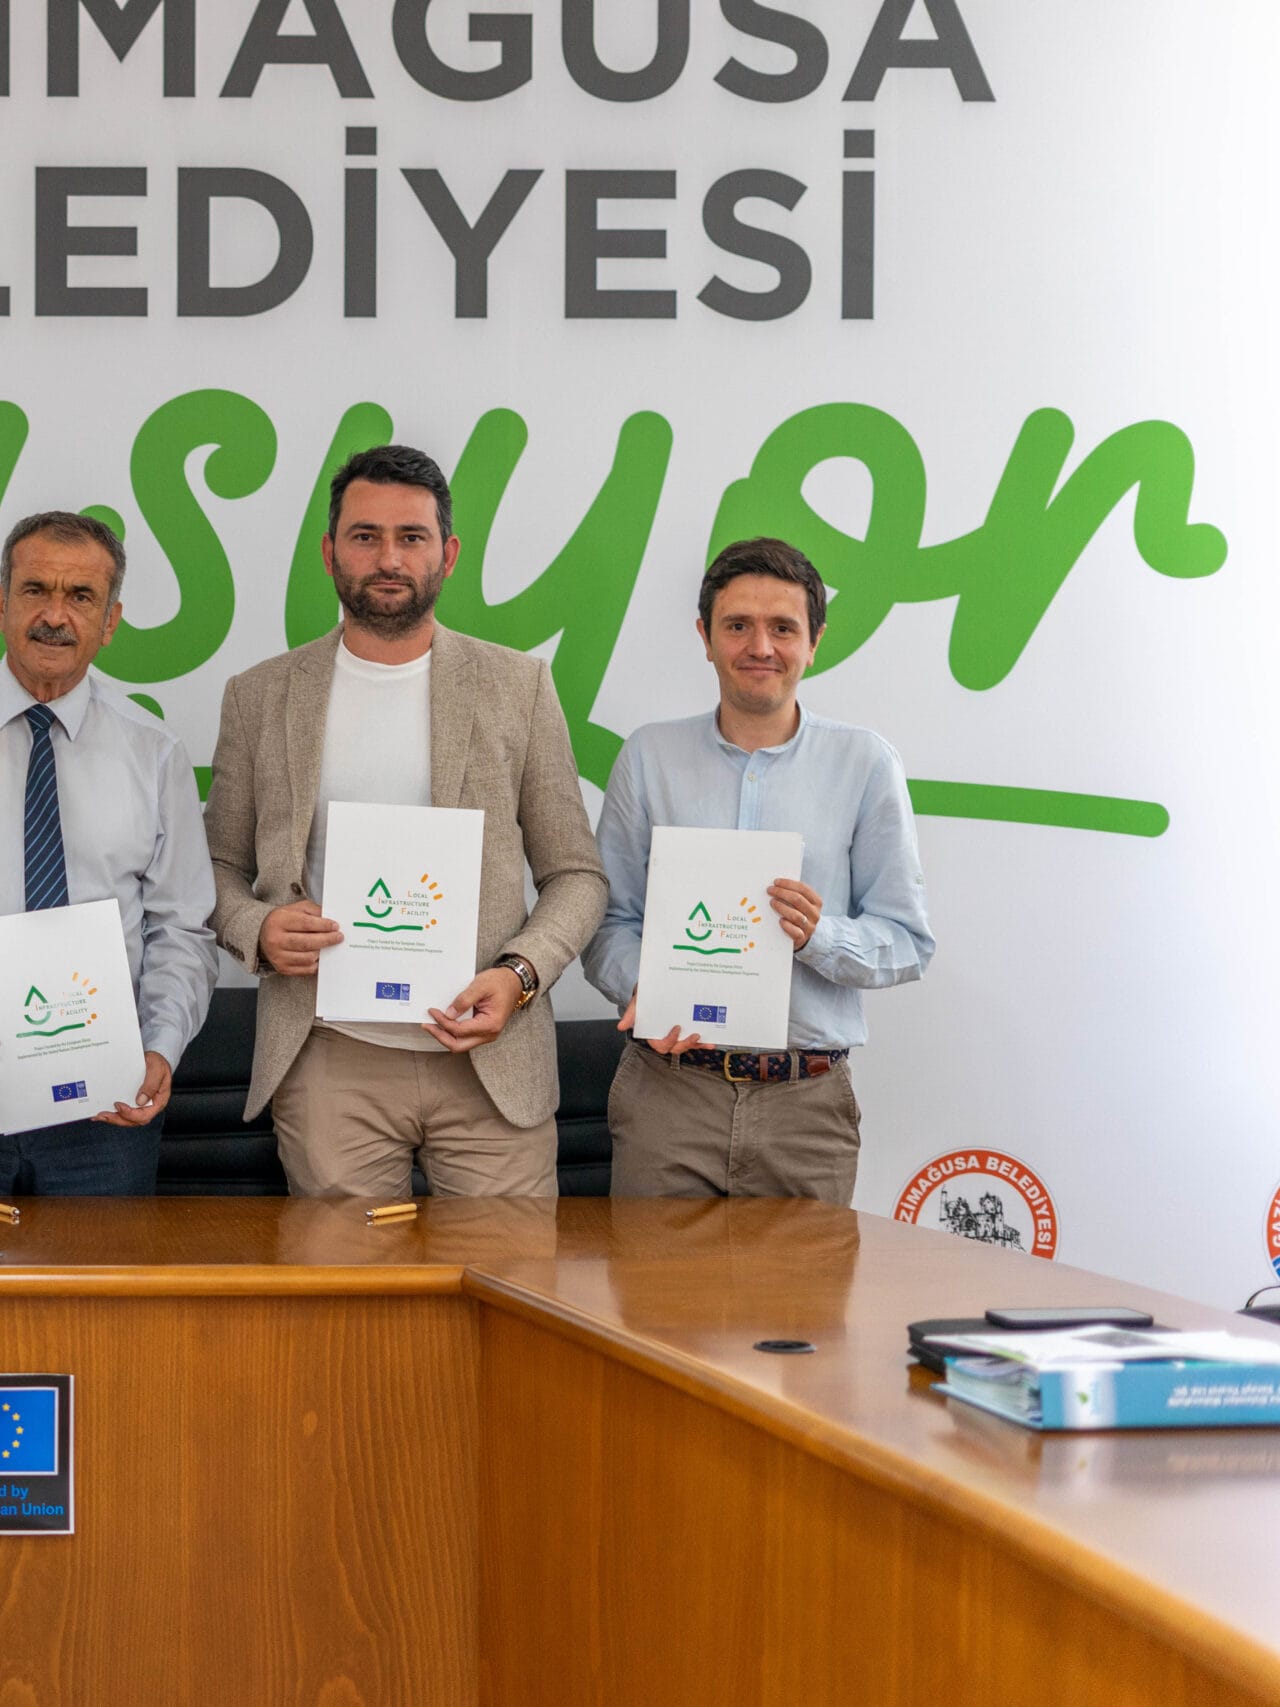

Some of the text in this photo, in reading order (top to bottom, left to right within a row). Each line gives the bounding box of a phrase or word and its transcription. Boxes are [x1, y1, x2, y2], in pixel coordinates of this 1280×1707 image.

[898, 1155, 1054, 1251] ZİMAĞUSA BELEDİYESİ
[11, 1484, 29, 1500] by
[21, 1503, 64, 1516] Union
